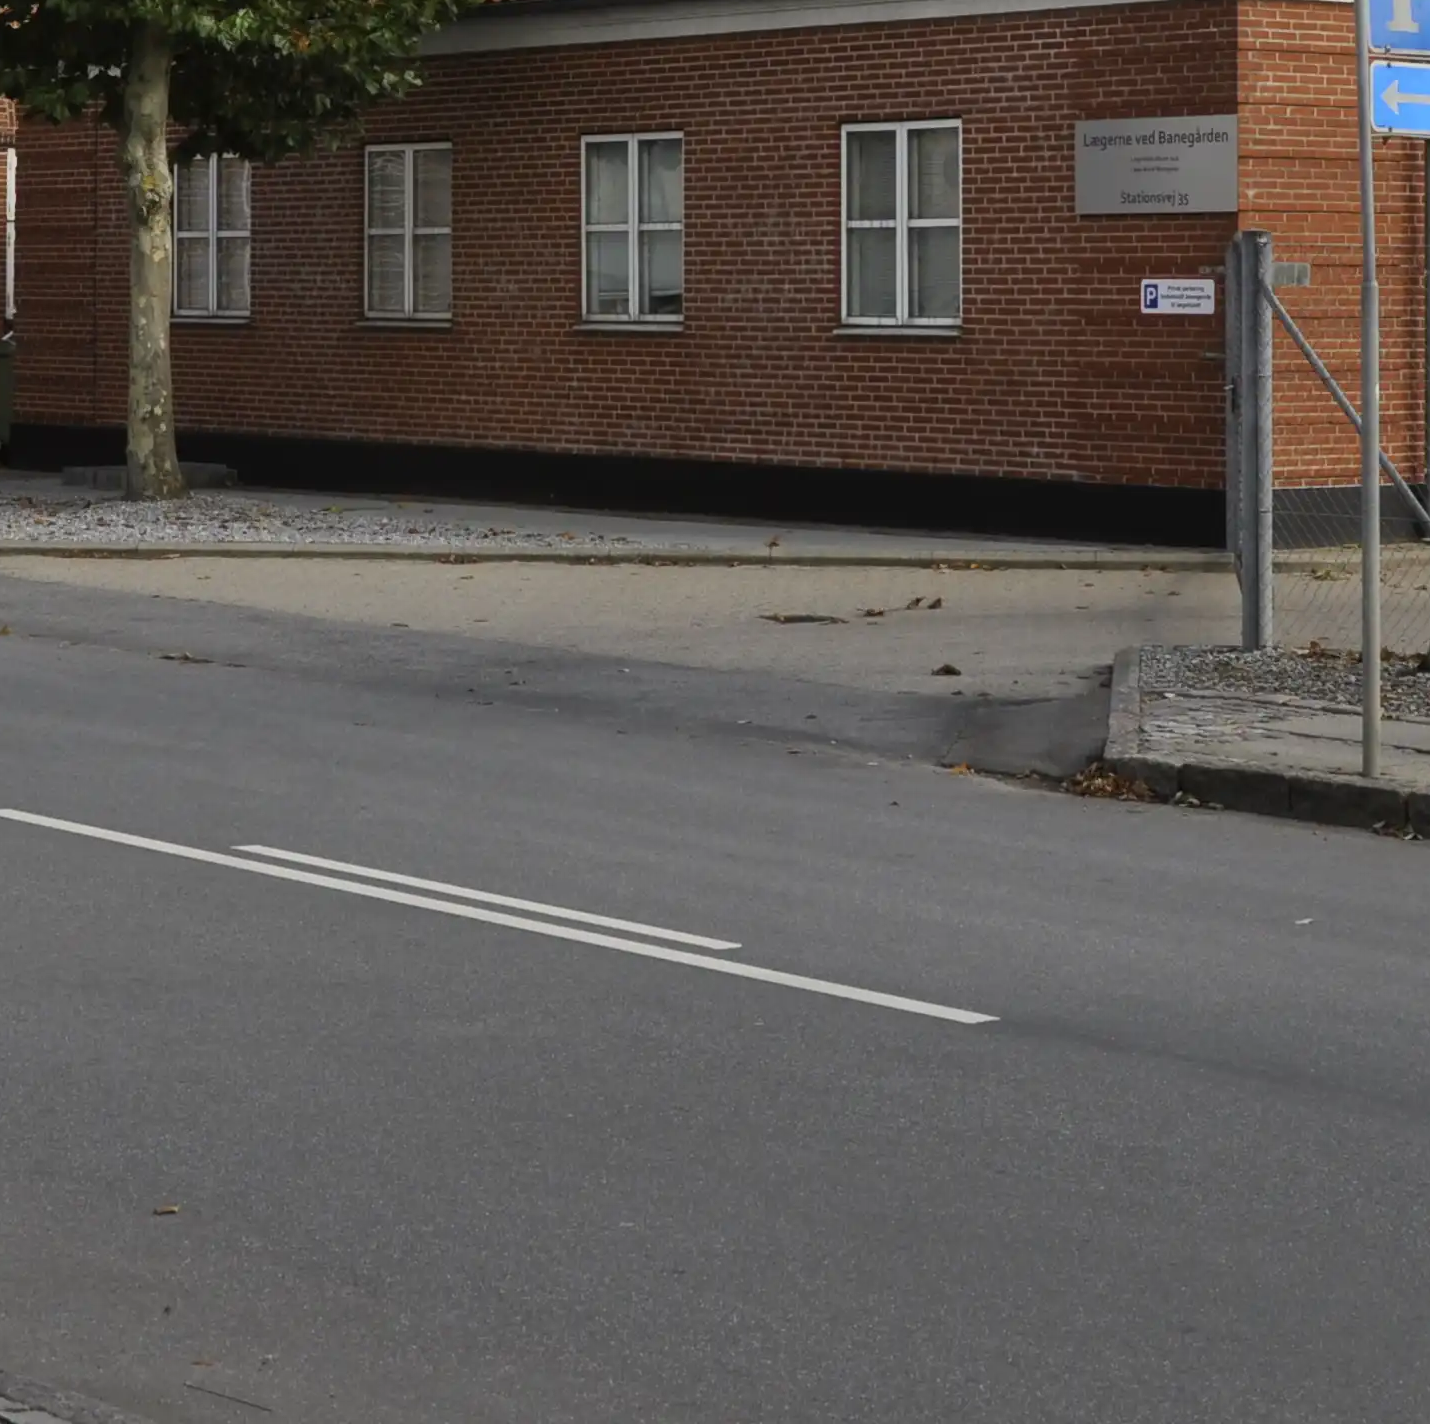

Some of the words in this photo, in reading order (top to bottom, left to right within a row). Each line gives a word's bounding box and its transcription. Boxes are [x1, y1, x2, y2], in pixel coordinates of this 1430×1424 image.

[1083, 132, 1133, 151] Lægerne
[1135, 129, 1156, 146] ved
[1158, 125, 1229, 147] Banegården
[1120, 189, 1176, 207] Stationsvej
[1146, 287, 1157, 306] P
